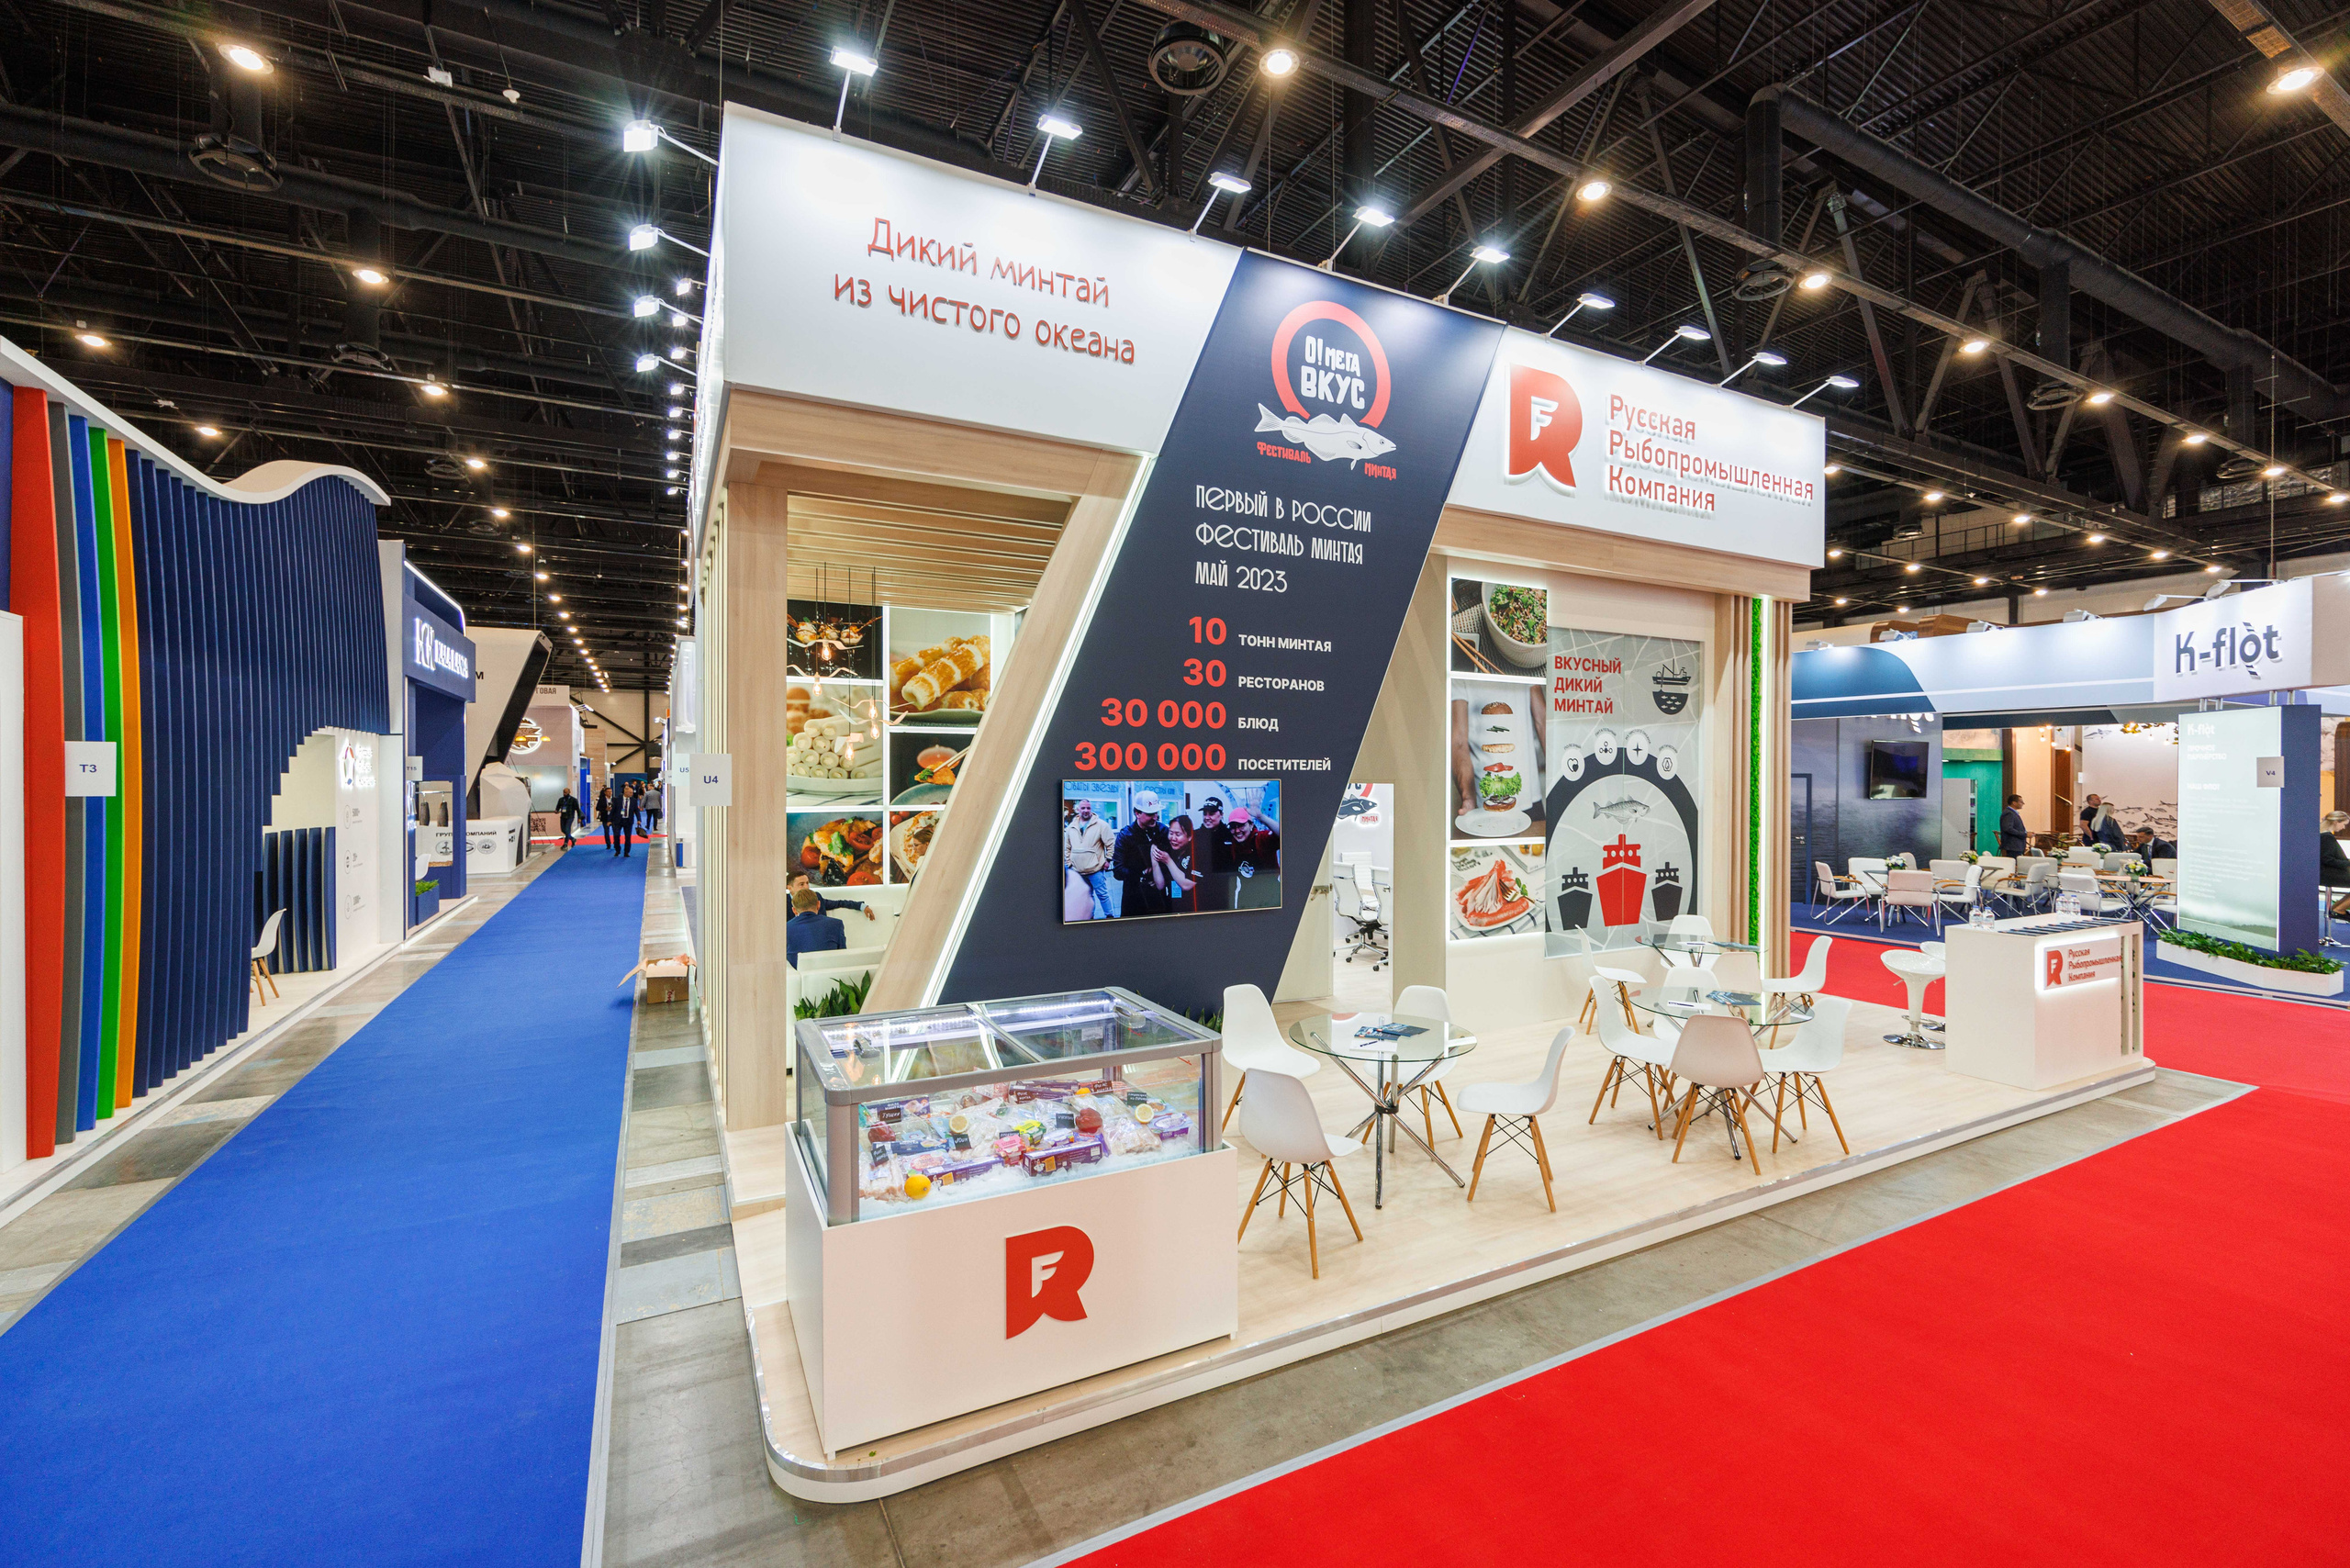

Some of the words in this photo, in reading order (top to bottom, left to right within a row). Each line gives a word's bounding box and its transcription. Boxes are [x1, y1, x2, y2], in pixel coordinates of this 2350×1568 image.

[867, 218, 977, 275] Дикий
[990, 256, 1109, 308] минтай
[834, 274, 872, 308] из
[888, 285, 1021, 340] чистого
[1035, 319, 1135, 365] океана
[1301, 365, 1365, 409] ВКУС
[1610, 394, 1696, 441] Русская
[1257, 442, 1311, 464] ФЕСТИВАЛЬ
[1609, 430, 1814, 500] Рыбопромышленная
[1364, 462, 1397, 481] МИНТАЯ
[1609, 465, 1715, 512] Компания
[1195, 485, 1268, 517] ПЕРВЫЙ
[1276, 498, 1284, 520] В
[1292, 499, 1371, 532] РОССИИ
[1195, 522, 1304, 556] ФЕСТИВАЛЬ
[1311, 537, 1363, 565] МИНТАЯ
[1195, 559, 1228, 588] МАЙ
[1236, 566, 1288, 593] 2023
[1189, 616, 1227, 645] 10
[1238, 633, 1276, 649] ТОНН
[1278, 637, 1331, 653] МИНТАЯ
[1182, 657, 1227, 688] 30
[1238, 676, 1325, 691] РЕСТОРАНОВ
[1554, 655, 1621, 674] ВКУСНЫЙ
[1554, 676, 1602, 694] ДИКИЙ
[1101, 698, 1147, 727] 30
[1157, 700, 1226, 729] 000
[1237, 717, 1279, 732] БЛЮД
[1554, 698, 1613, 714] МИНТАЙ
[79, 764, 97, 773] T3
[1074, 742, 1147, 771] 300
[1157, 743, 1226, 771] 000
[1238, 757, 1331, 771] ПОСЕТИТЕЛЕЙ
[703, 776, 718, 784] U4
[2068, 948, 2090, 959] Русская
[2068, 971, 2096, 982] Компания
